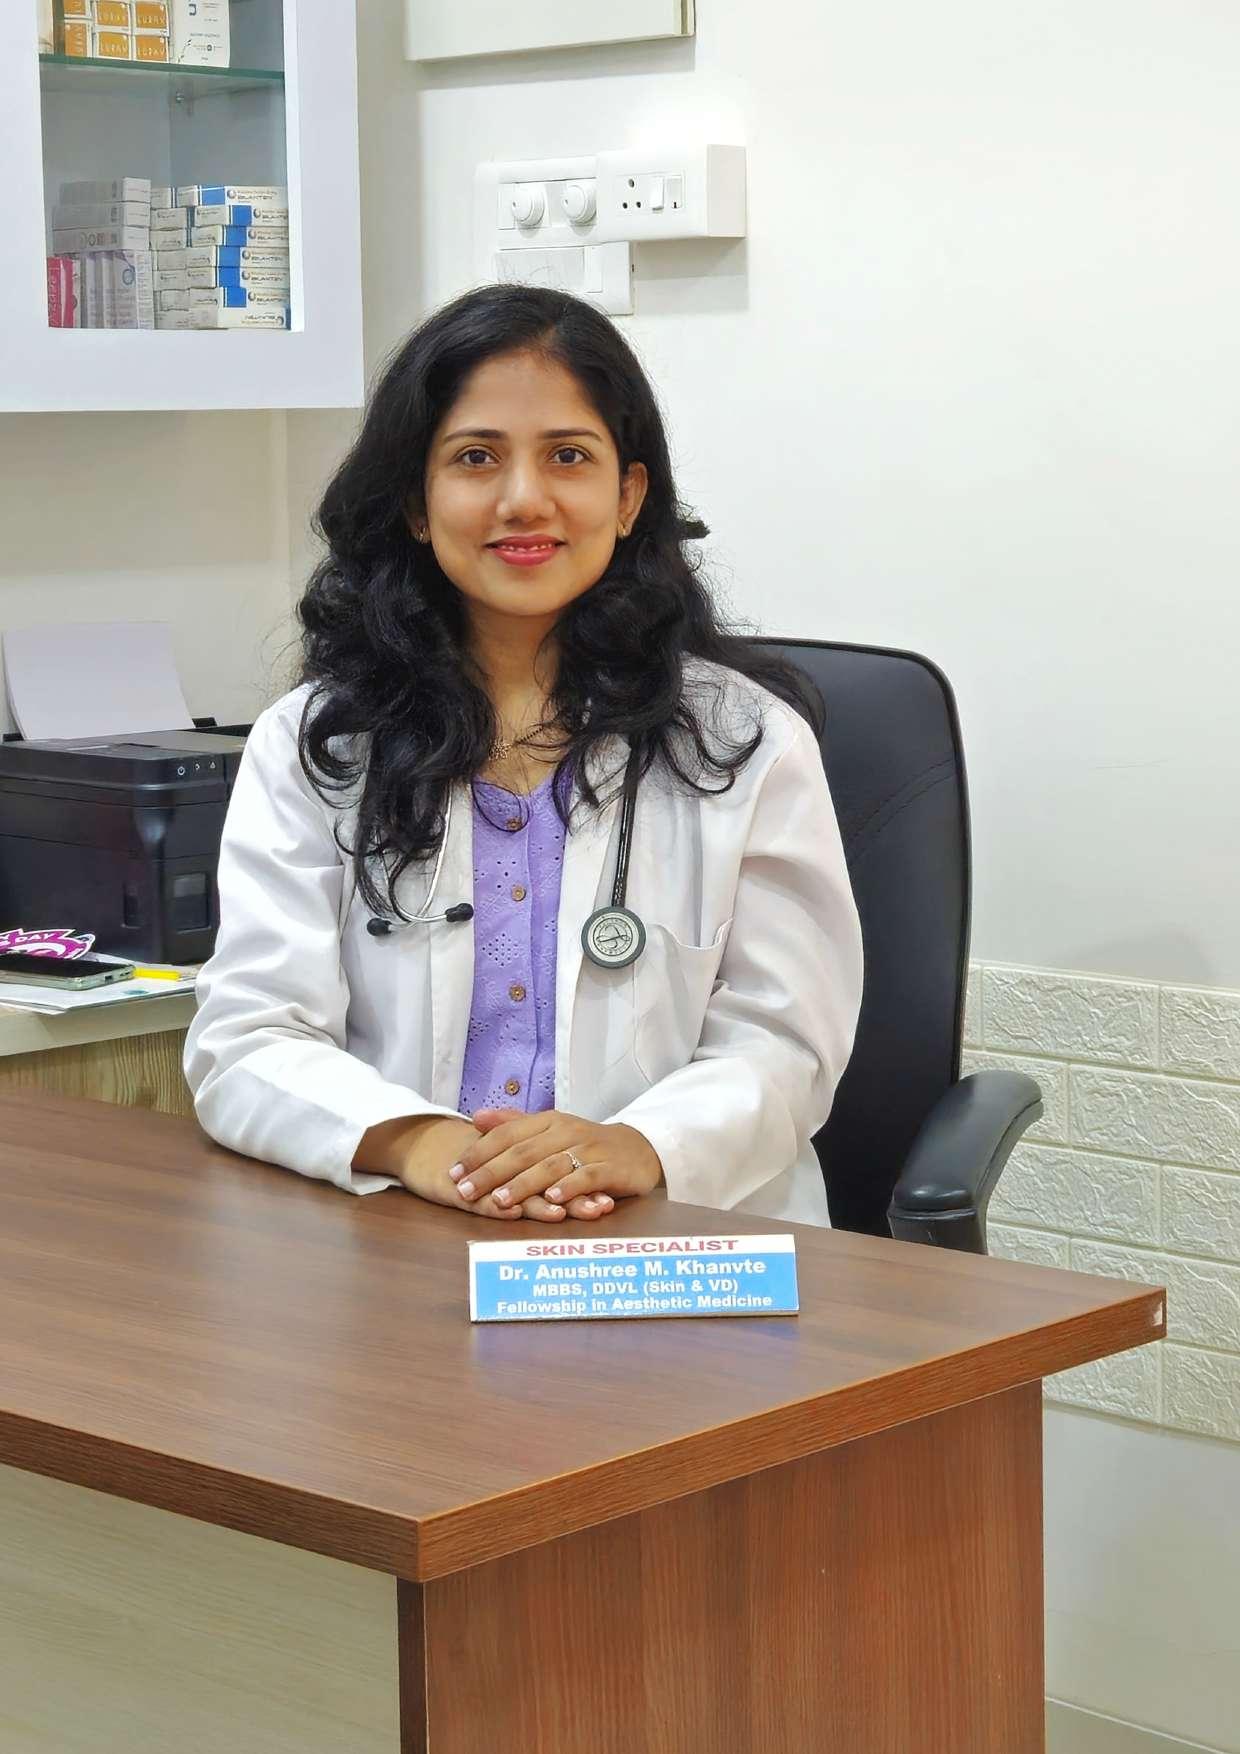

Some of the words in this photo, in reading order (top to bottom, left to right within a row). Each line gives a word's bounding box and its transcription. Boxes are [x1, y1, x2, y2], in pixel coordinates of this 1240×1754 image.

[526, 1244, 585, 1256] SKIN
[592, 1240, 739, 1255] SPECIALIST
[499, 1265, 529, 1281] Dr.
[536, 1262, 638, 1280] Anushree
[644, 1261, 670, 1277] M.
[533, 1283, 588, 1298] MBBS,
[592, 1282, 639, 1295] DDVL
[643, 1281, 685, 1296] (Skin
[691, 1280, 704, 1292] &
[708, 1279, 739, 1294] VD)
[497, 1300, 587, 1315] Fellowship
[592, 1299, 607, 1311] in
[612, 1296, 693, 1311] Aesthetic
[697, 1294, 773, 1308] Medicine
